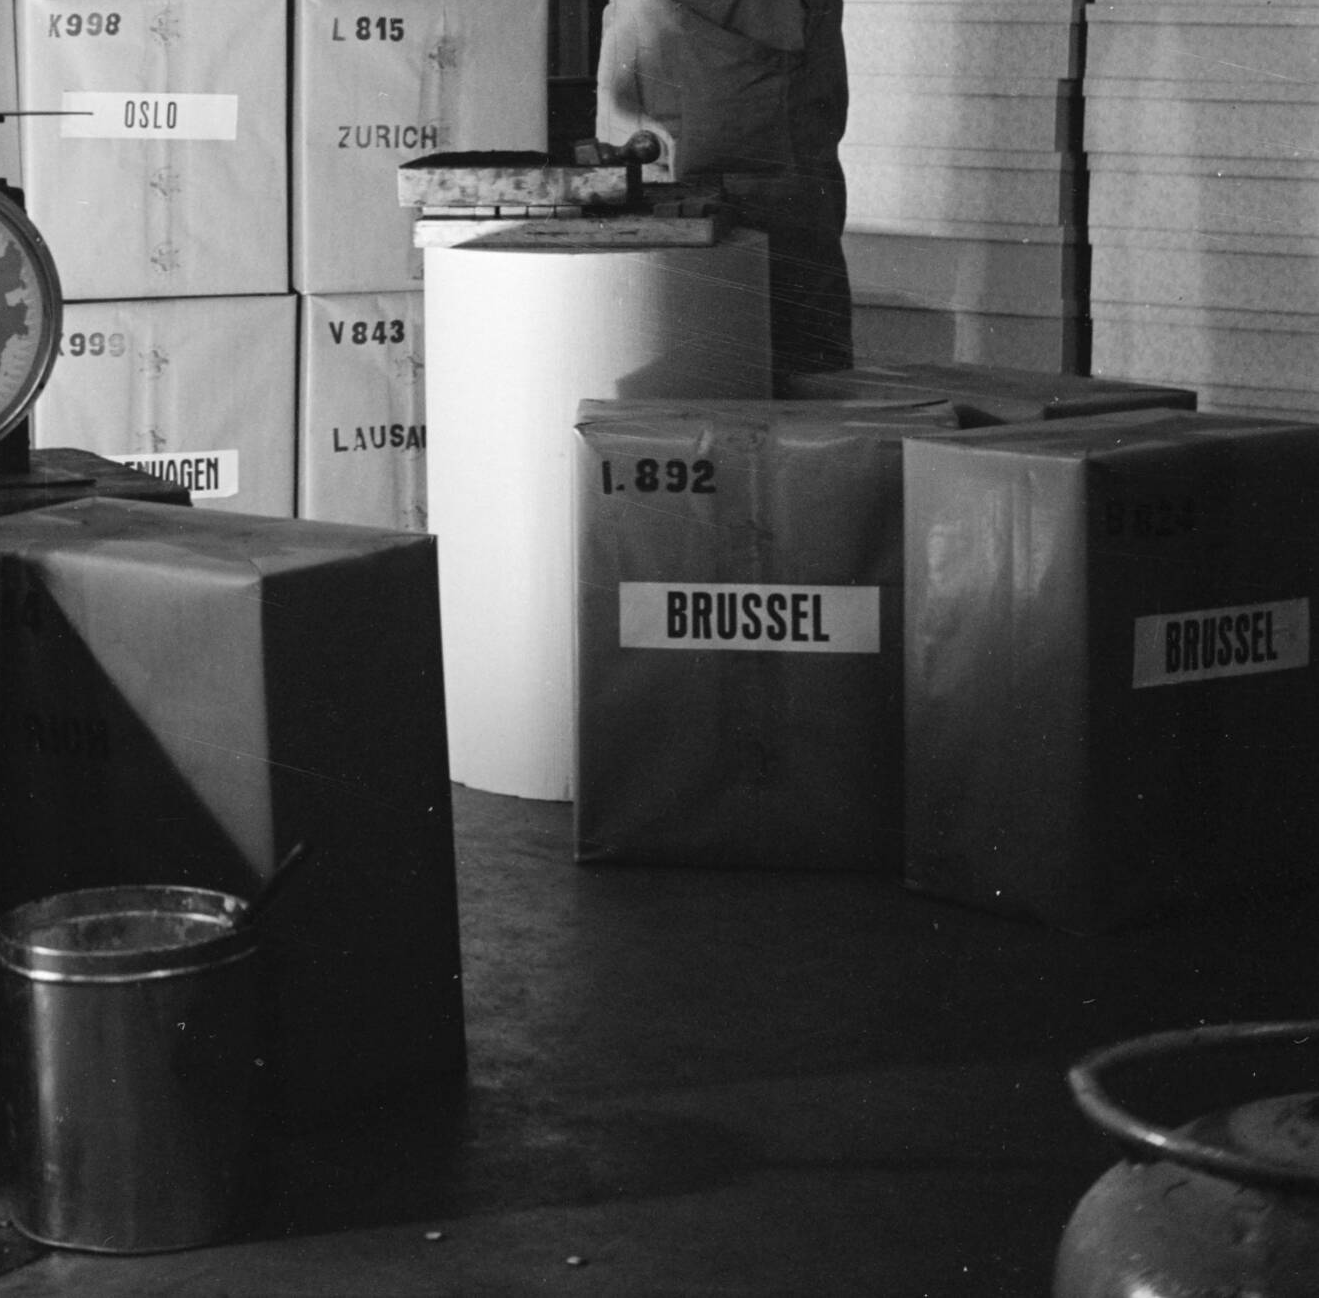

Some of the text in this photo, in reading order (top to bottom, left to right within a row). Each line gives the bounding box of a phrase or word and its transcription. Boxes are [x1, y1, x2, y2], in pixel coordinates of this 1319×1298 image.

[125, 100, 177, 129] OSLO
[338, 125, 438, 149] ZURICH
[667, 591, 830, 642] BRUSSEL
[1165, 611, 1278, 673] BRUSSEL
